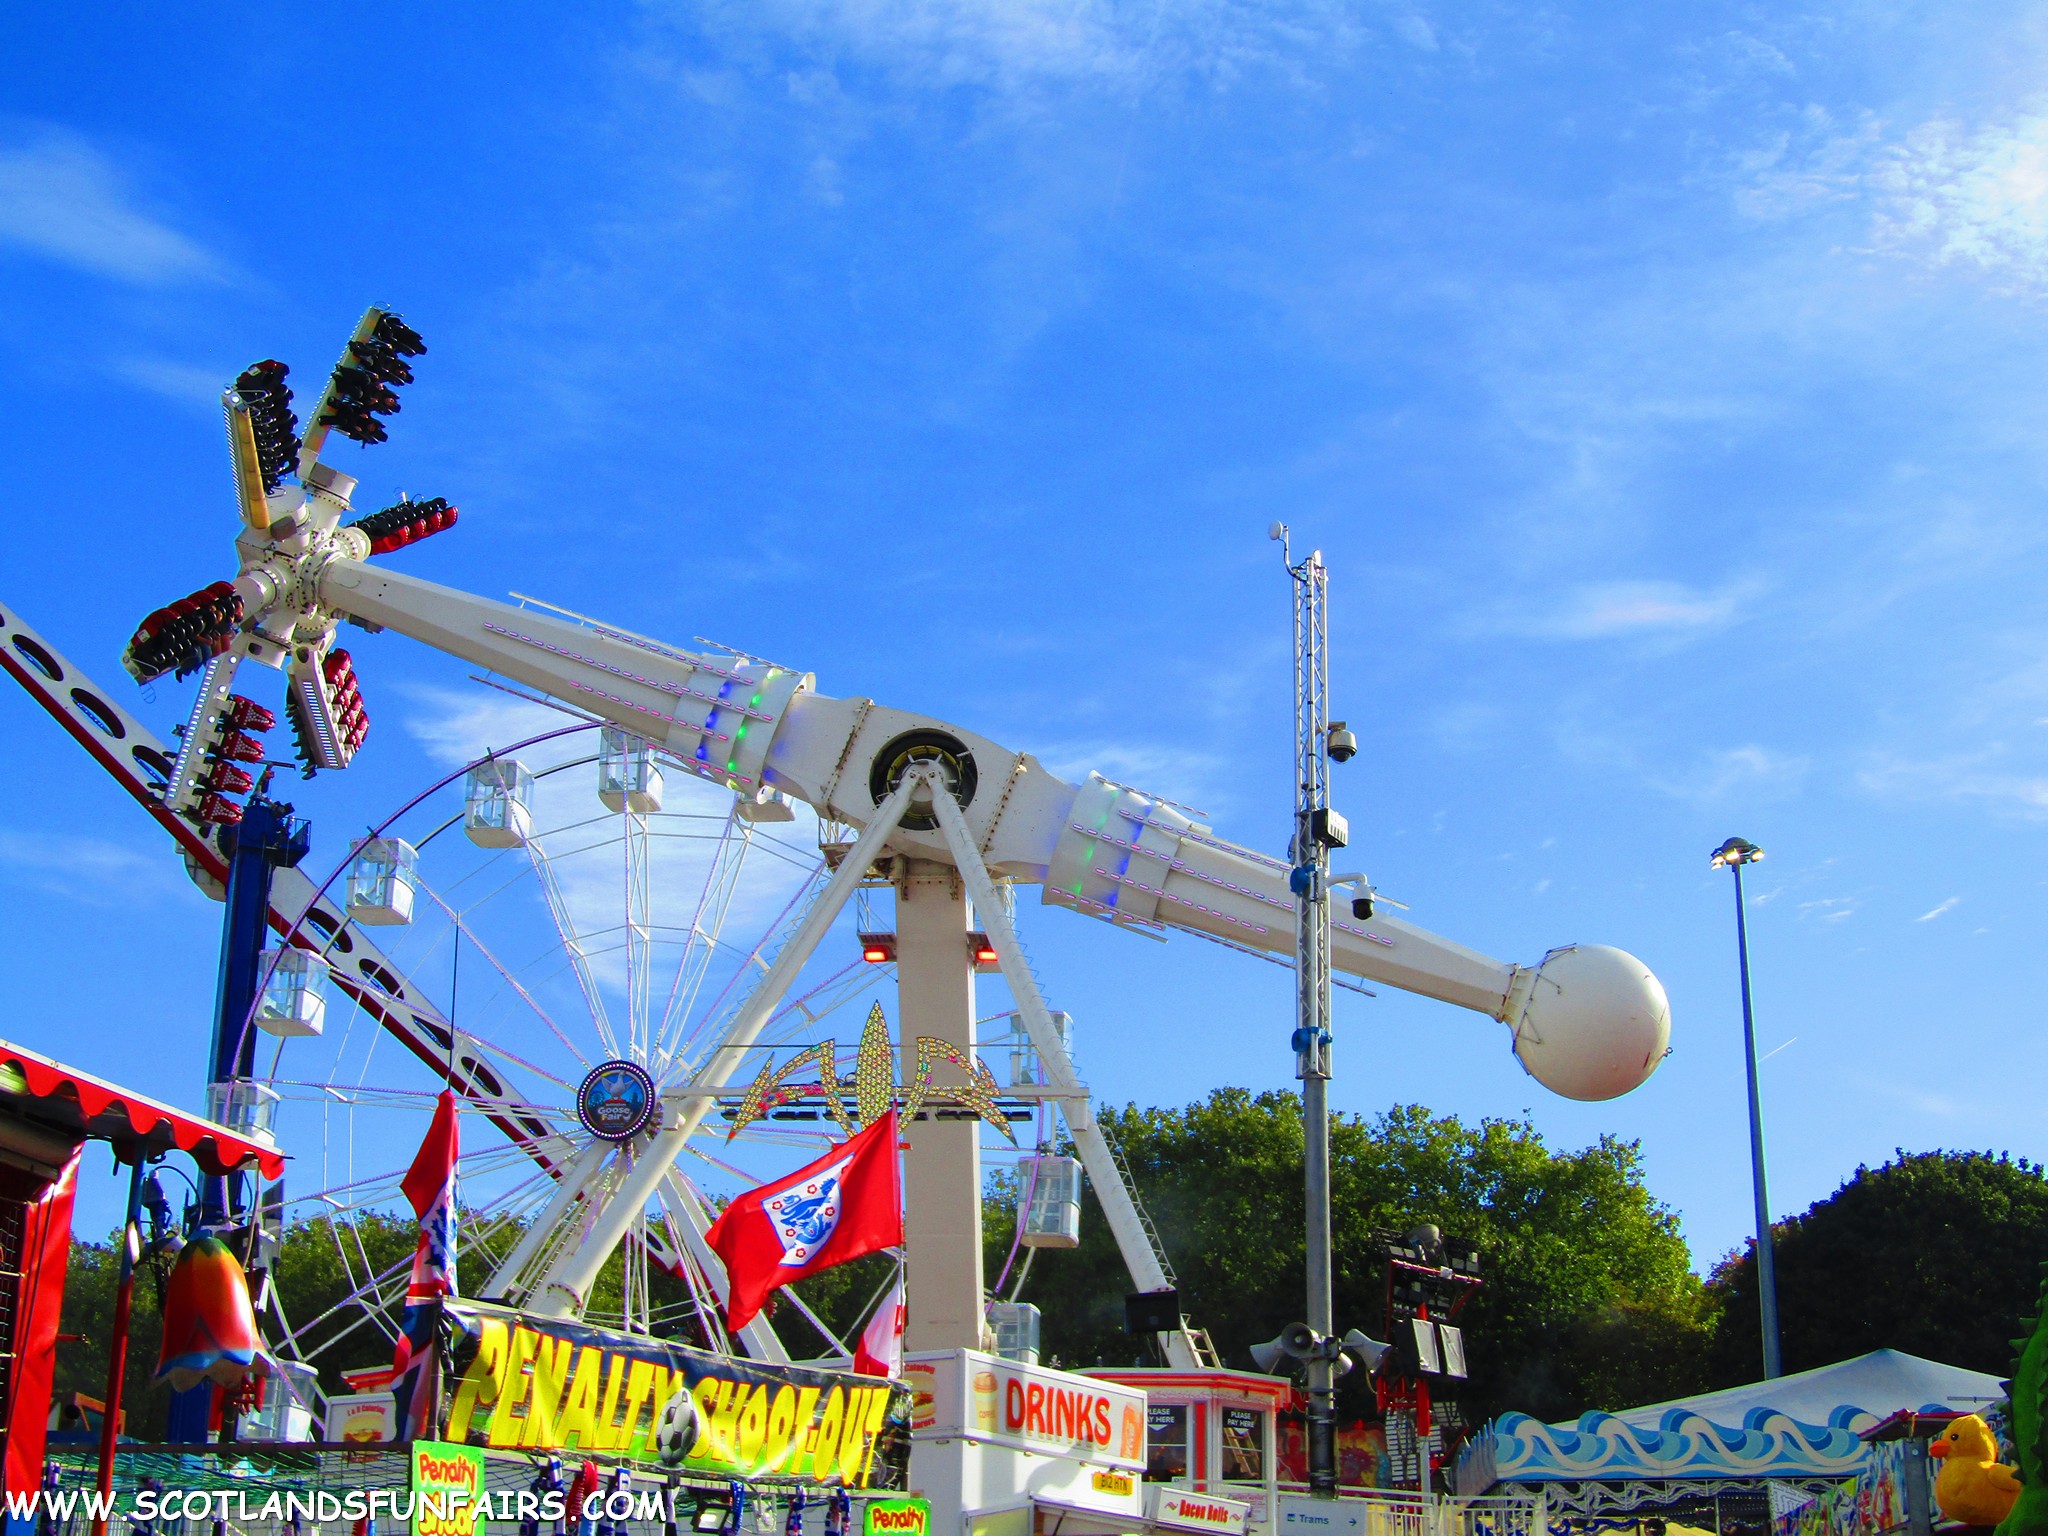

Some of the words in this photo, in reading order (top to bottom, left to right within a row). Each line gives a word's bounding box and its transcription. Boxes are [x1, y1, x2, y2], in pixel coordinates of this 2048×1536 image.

[598, 1106, 630, 1115] Goose
[601, 1112, 622, 1120] Fair
[446, 1316, 685, 1452] PENALTY
[688, 1376, 891, 1490] SHOOT-OUT
[1005, 1376, 1112, 1448] DRINKS
[1230, 1411, 1252, 1420] PLEASE
[1156, 1416, 1175, 1424] HERE
[1227, 1418, 1239, 1427] PAY
[1240, 1420, 1255, 1428] HERE
[418, 1452, 478, 1493] Penalty
[1179, 1499, 1206, 1520] Bacon
[1207, 1503, 1229, 1523] Rolls
[872, 1506, 925, 1534] Penalty
[1299, 1514, 1330, 1525] Trams
